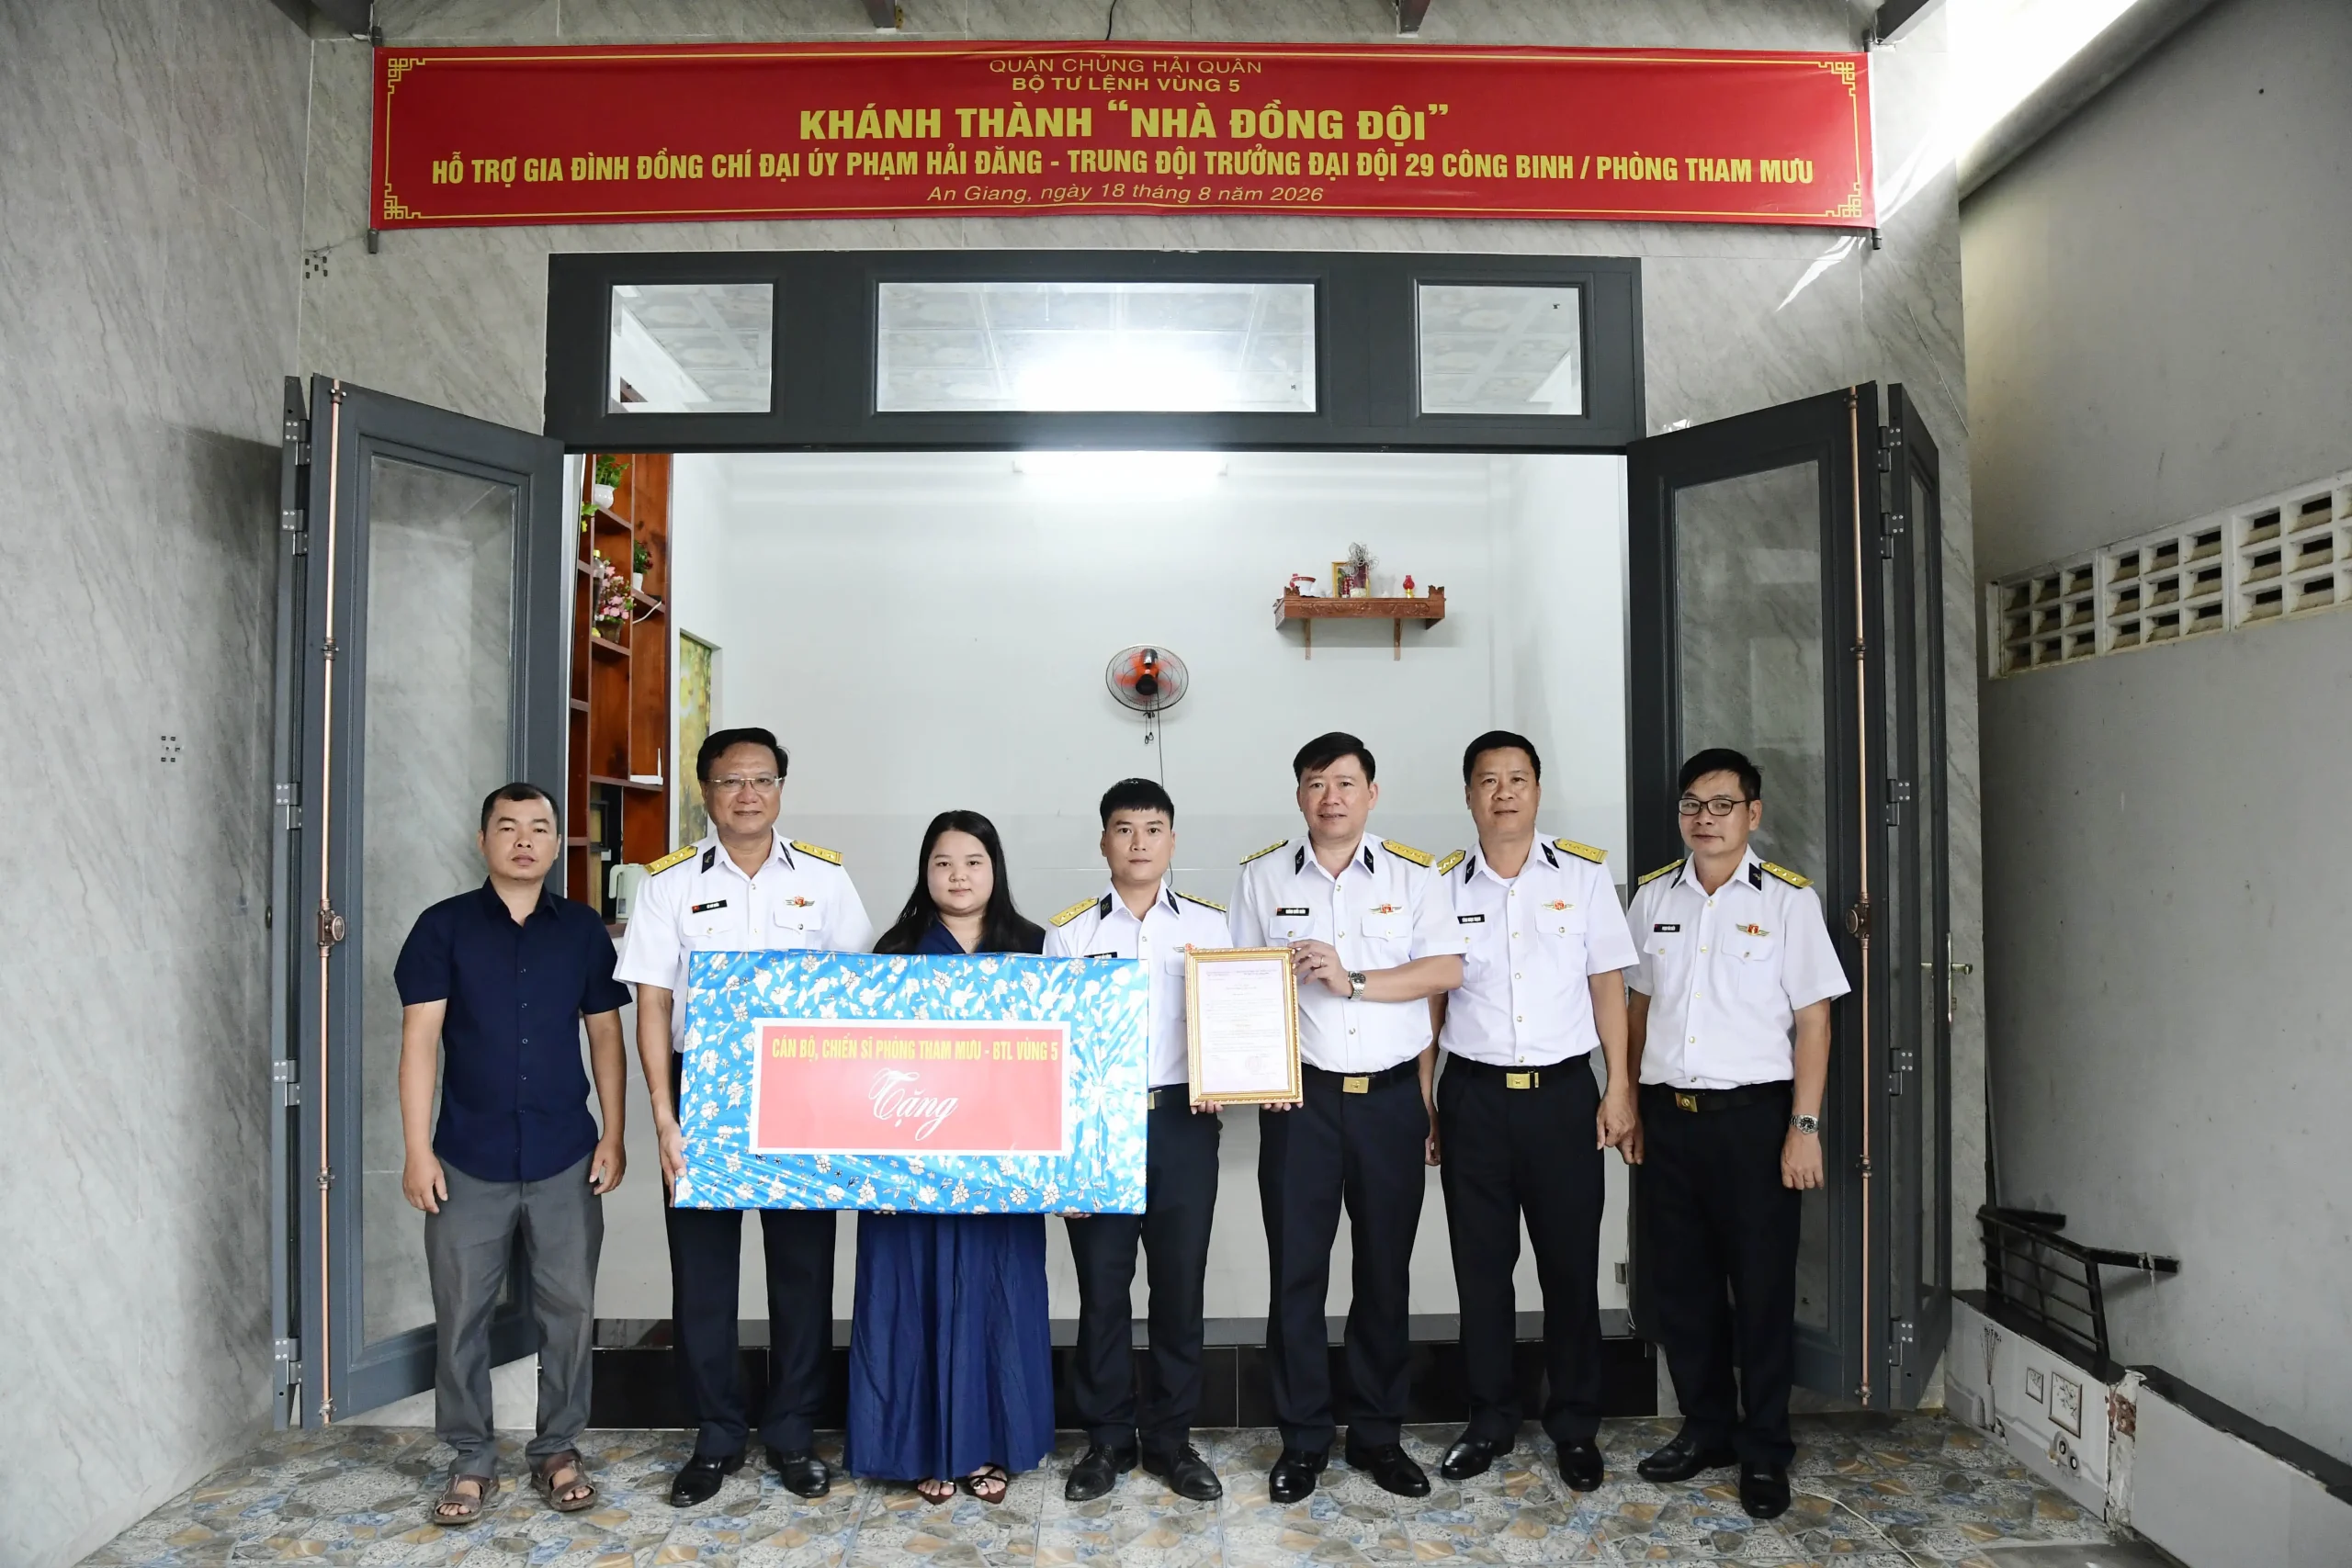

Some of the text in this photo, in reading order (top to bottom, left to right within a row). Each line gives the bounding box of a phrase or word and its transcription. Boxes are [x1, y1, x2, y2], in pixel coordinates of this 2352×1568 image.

[989, 54, 1261, 73] QUÂN CHỦNG HẢI QUÂN
[1012, 74, 1240, 93] BỘ TƯ LỆNH VÙNG 5
[800, 102, 941, 140] KHÁNH
[955, 101, 1092, 138] THÀNH
[1229, 98, 1343, 140] ĐỒNG
[432, 151, 464, 184] HỖ
[471, 155, 517, 187] TRỢ
[524, 158, 564, 183] GIA
[571, 152, 629, 182] ĐÌNH
[637, 147, 704, 180] ĐỒNG
[711, 147, 752, 178] CHÍ
[759, 152, 800, 183] ĐẠI
[808, 146, 839, 177] ÚY
[846, 151, 919, 181] PHẠM
[926, 142, 967, 175] HẢI
[974, 146, 1043, 175] ĐĂNG
[1067, 149, 1148, 174] TRUNG
[1155, 144, 1196, 180] ĐỘI
[1204, 143, 1301, 176] TRƯỞNG
[1307, 152, 1349, 182] ĐẠI
[1356, 147, 1397, 182] ĐỘI
[1405, 152, 1434, 177] 29
[1442, 149, 1509, 178] CÔNG
[1515, 154, 1574, 179] BINH
[1579, 155, 1590, 180] /
[1596, 151, 1679, 181] PHÒNG
[1684, 157, 1753, 183] THAM
[1759, 157, 1815, 184] MƯU
[927, 184, 1323, 204] An Giang, ngày 18 tháng 8 năm 2026
[773, 1034, 797, 1058] CÁN
[822, 1032, 857, 1059] CHIẾN
[919, 1040, 952, 1059] THAM
[955, 1039, 981, 1060] MƯU
[992, 1041, 1013, 1060] BTL
[1016, 1037, 1047, 1061] VÙNG
[1050, 1042, 1058, 1061] 5
[868, 1067, 958, 1141] Tặng
